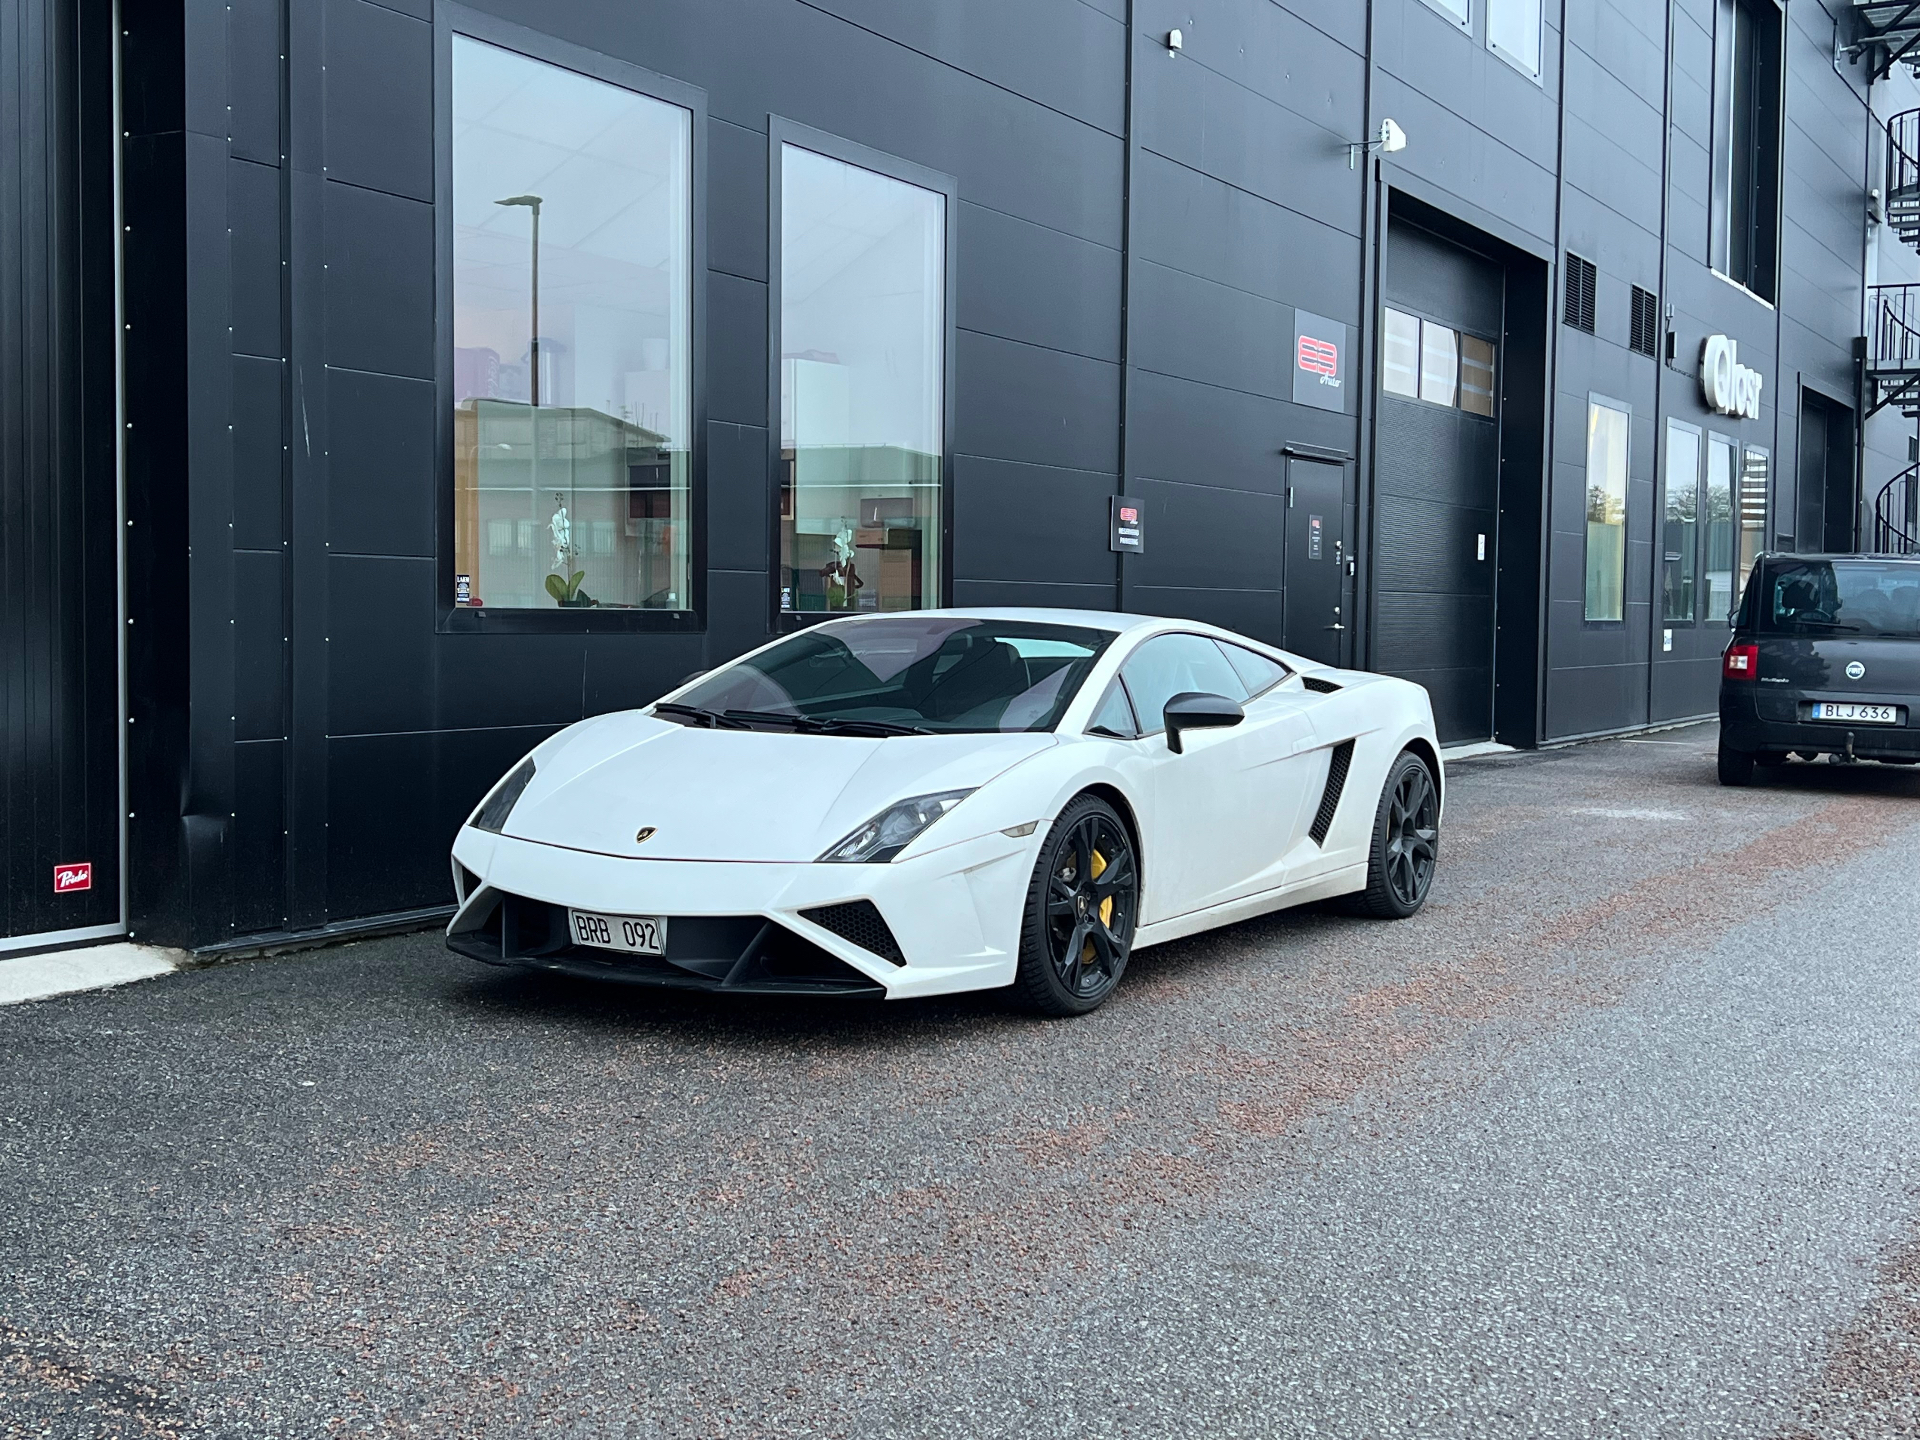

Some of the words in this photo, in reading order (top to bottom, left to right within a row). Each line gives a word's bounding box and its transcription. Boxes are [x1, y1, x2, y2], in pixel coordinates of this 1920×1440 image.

[1825, 704, 1855, 718] BLJ
[1859, 706, 1890, 720] 636
[575, 915, 611, 944] BRB
[622, 921, 660, 950] 092
